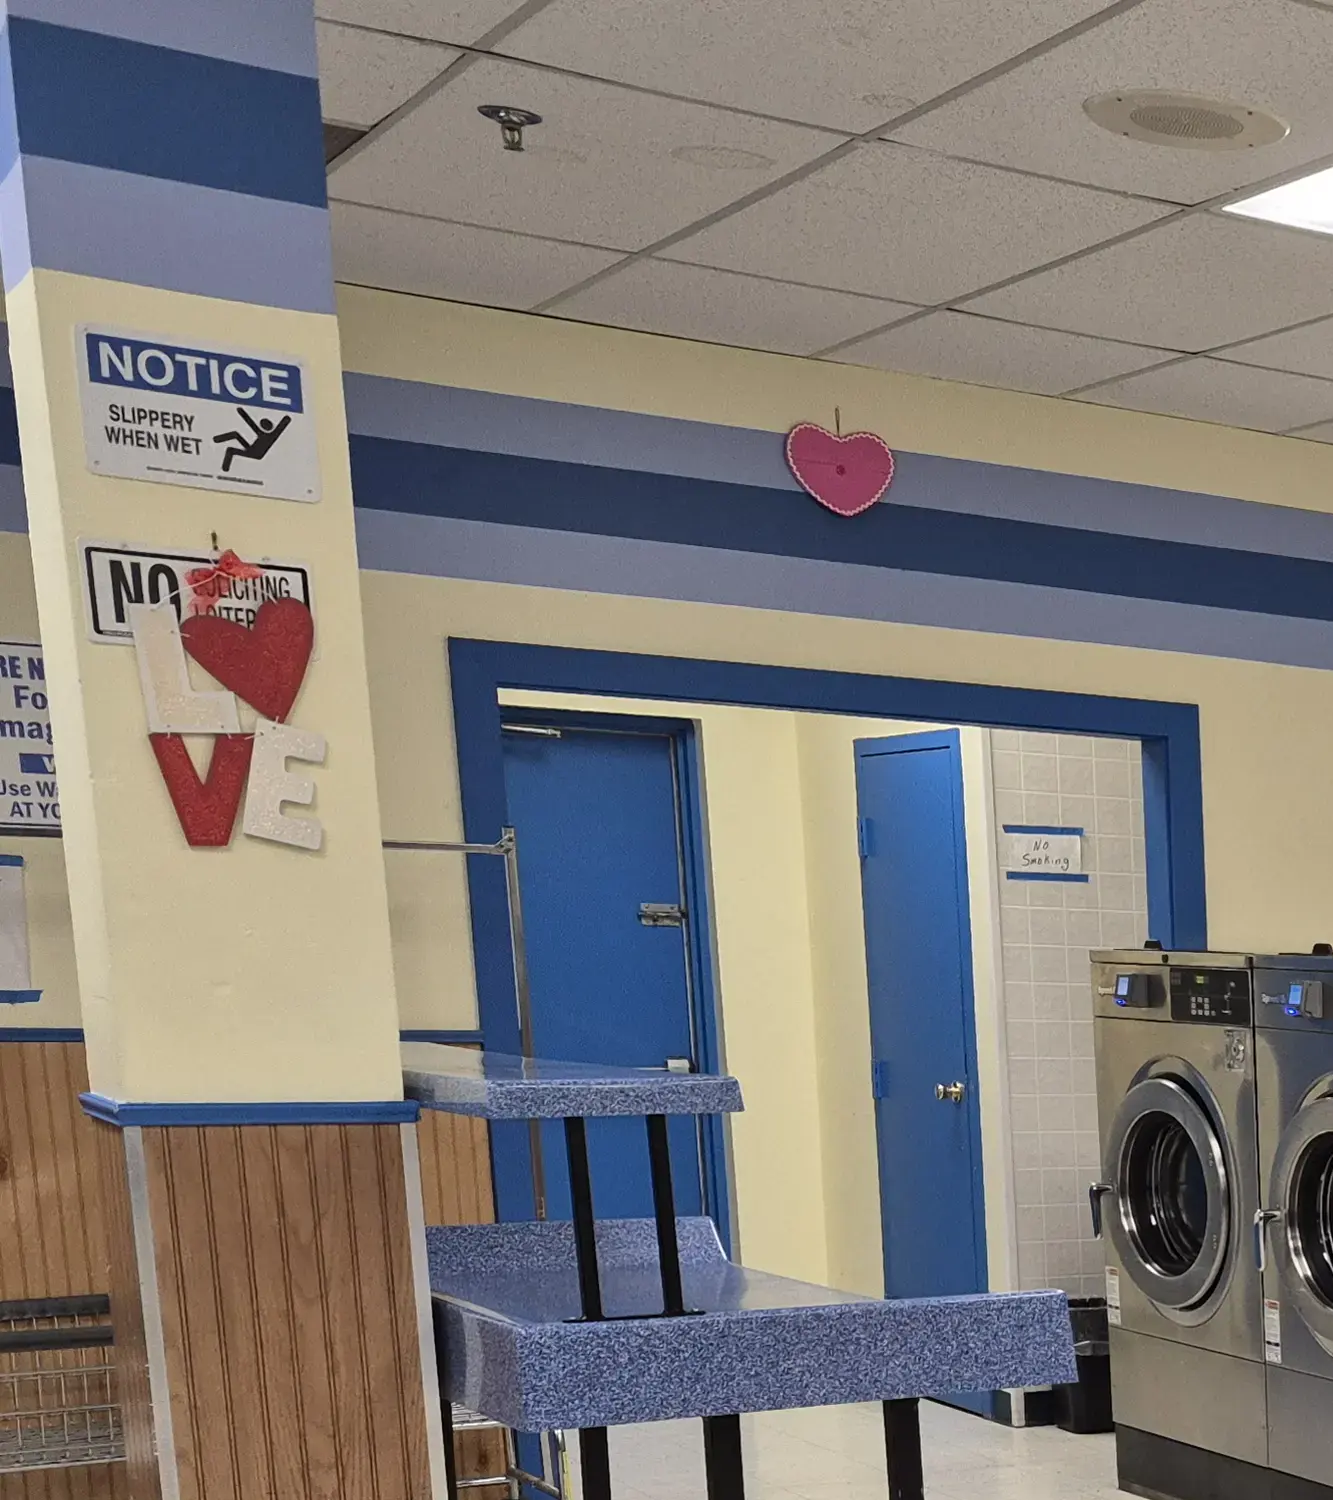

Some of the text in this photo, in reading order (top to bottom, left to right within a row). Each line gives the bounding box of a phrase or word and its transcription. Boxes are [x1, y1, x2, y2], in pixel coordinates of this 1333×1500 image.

[98, 341, 292, 406] NOTICE
[108, 404, 195, 433] SLIPPERY
[104, 425, 202, 456] WHEN WET
[109, 560, 181, 624] NO
[13, 684, 48, 710] Fo
[10, 801, 61, 819] AT YO
[1022, 853, 1070, 871] Smoking
